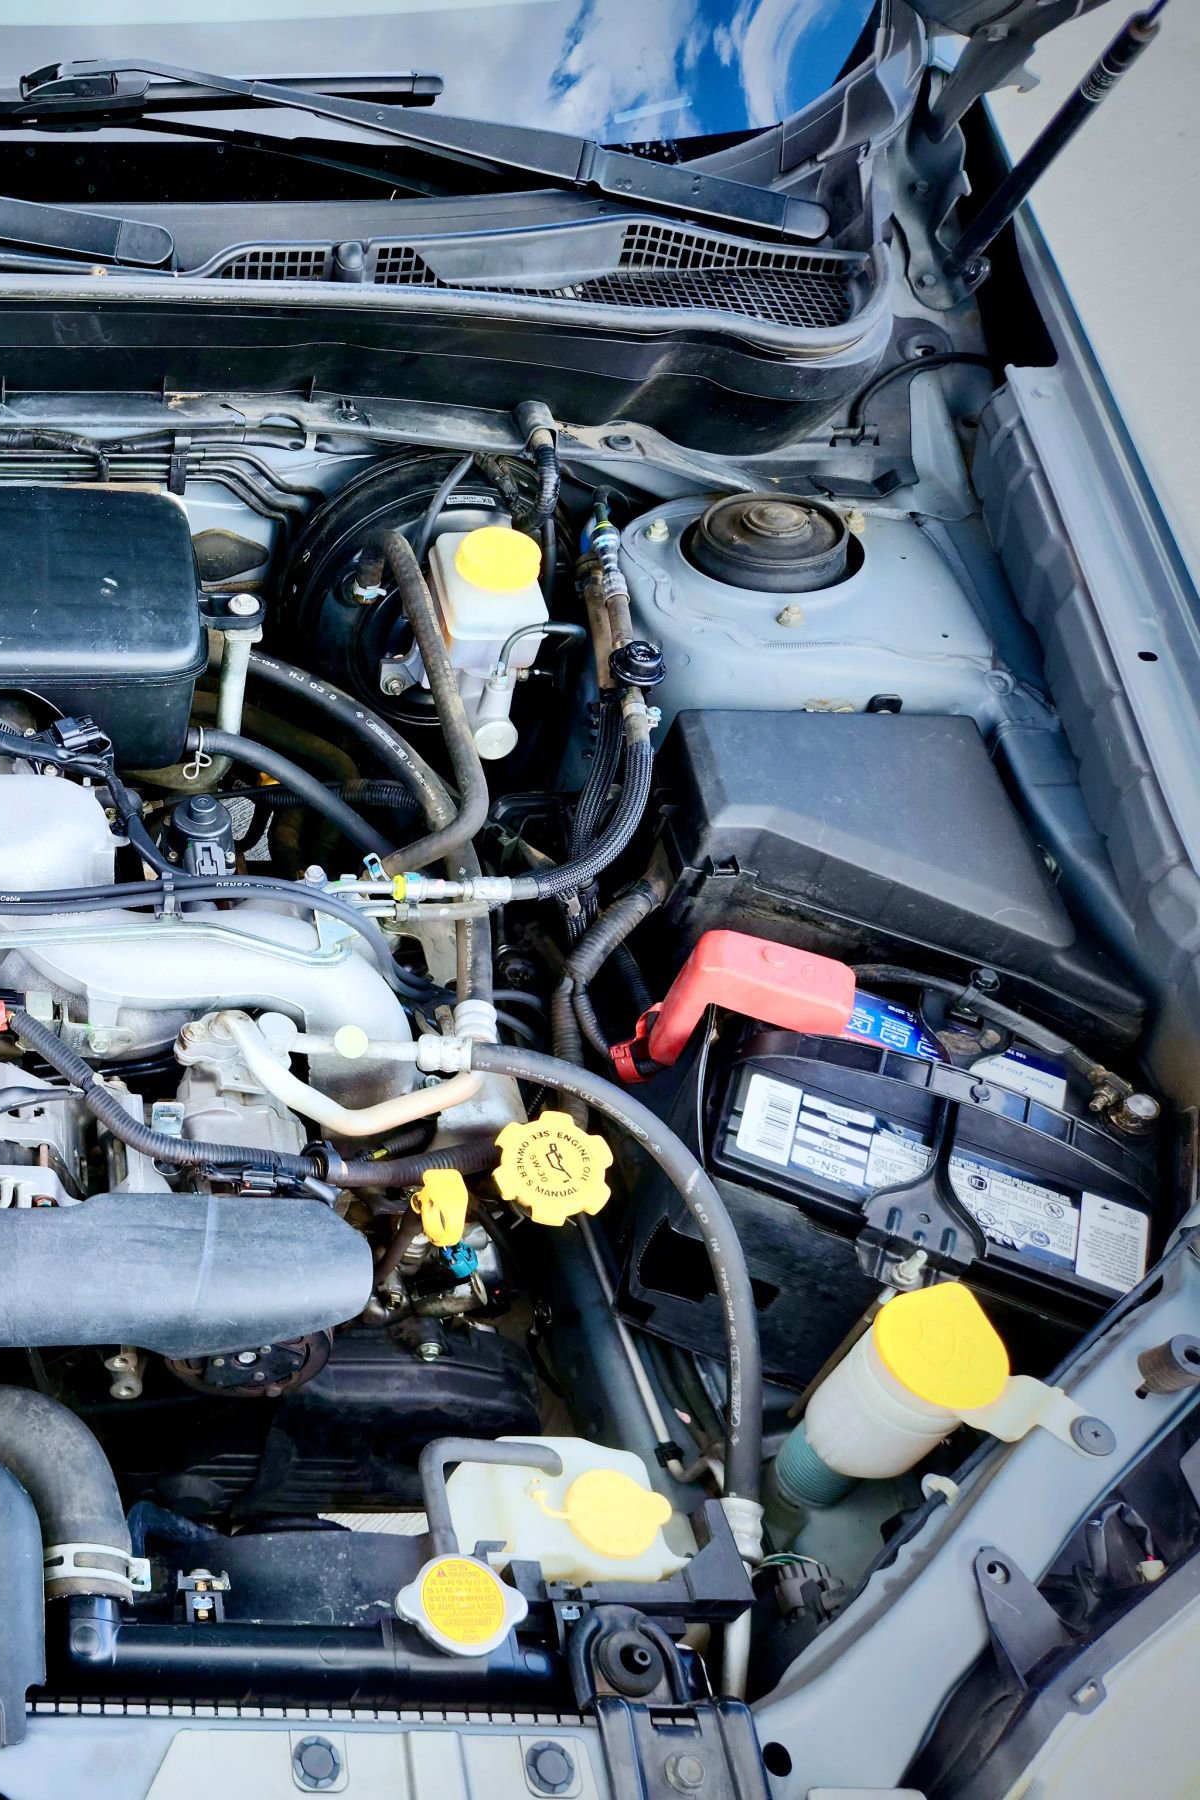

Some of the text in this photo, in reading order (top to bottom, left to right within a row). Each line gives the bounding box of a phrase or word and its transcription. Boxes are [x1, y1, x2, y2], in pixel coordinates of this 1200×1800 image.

[0, 893, 21, 904] Cable
[1024, 1075, 1055, 1089] Power
[531, 1130, 550, 1141] SEE
[556, 1131, 591, 1163] ENGINE
[529, 1154, 549, 1183] 5W-30
[535, 1186, 578, 1198] MANUAL
